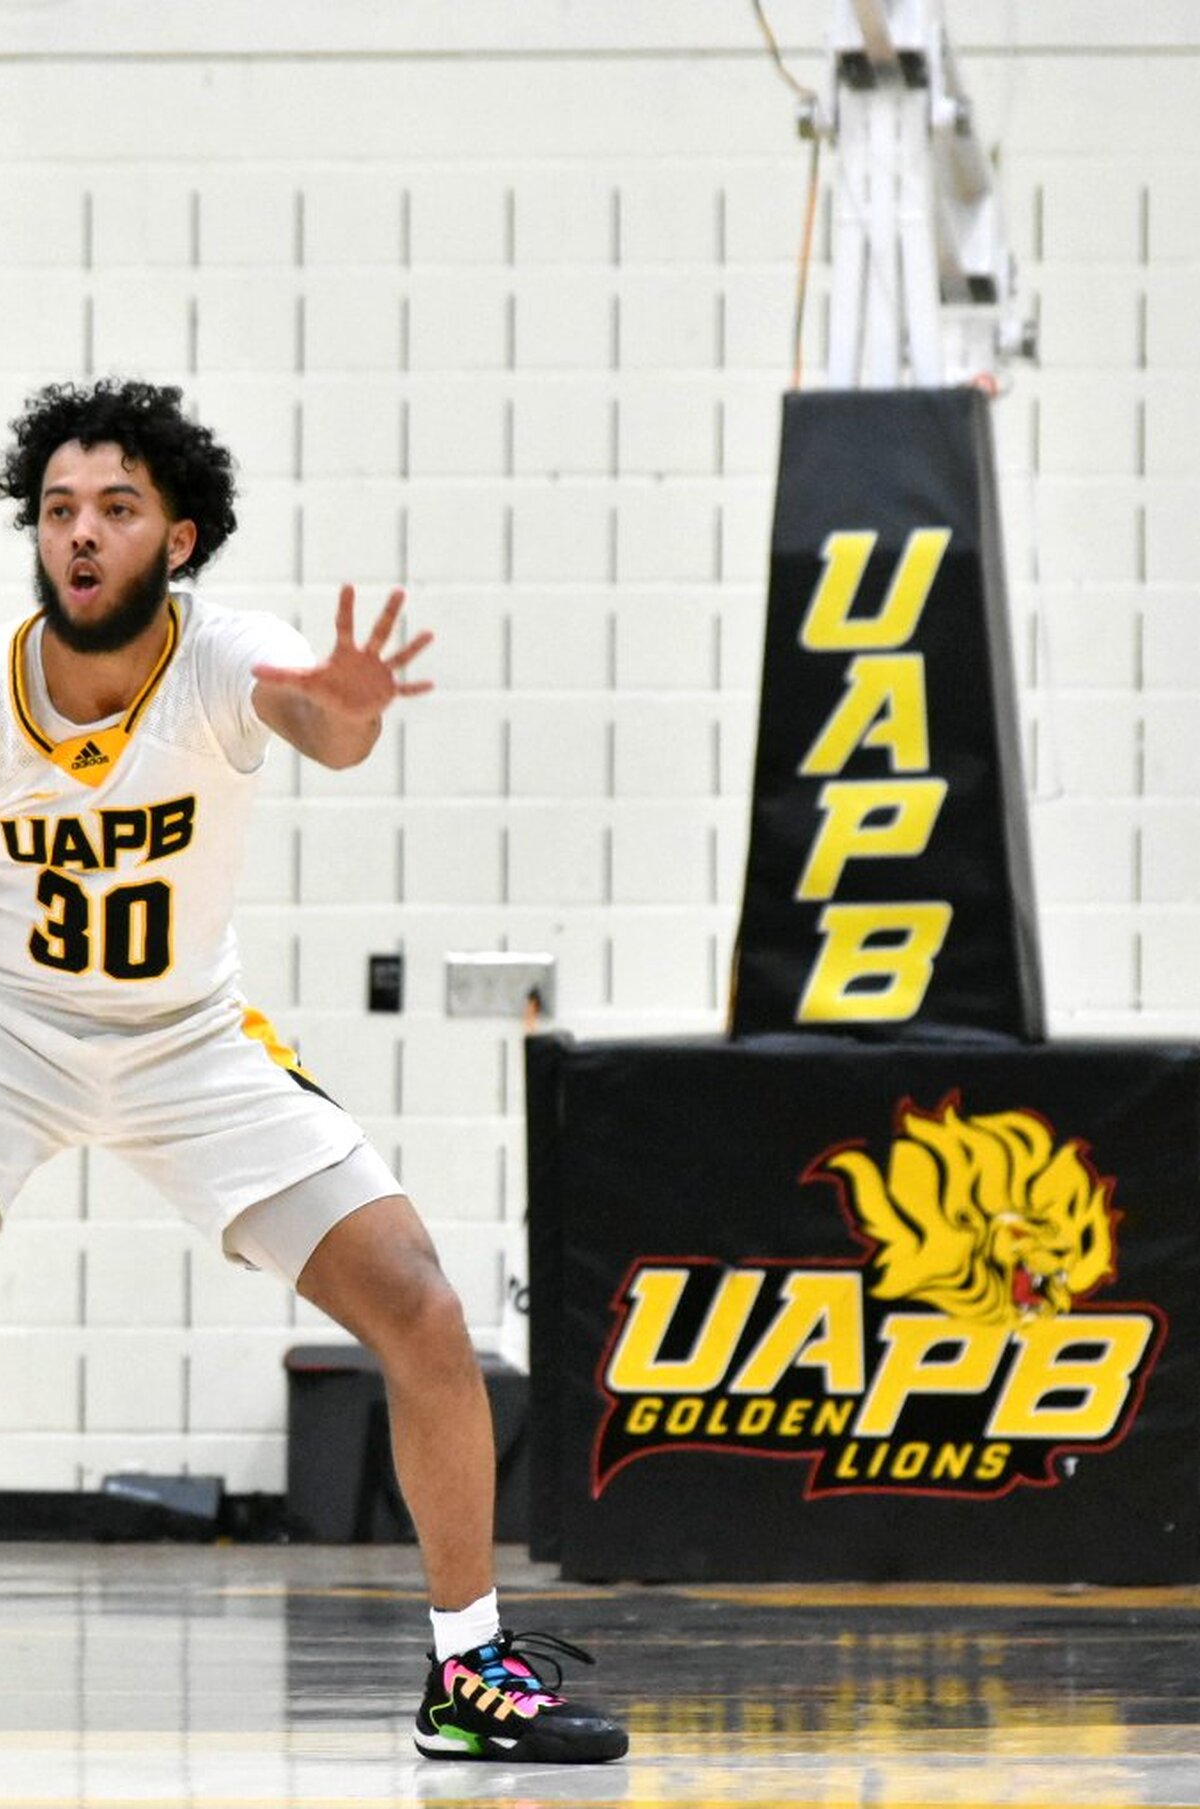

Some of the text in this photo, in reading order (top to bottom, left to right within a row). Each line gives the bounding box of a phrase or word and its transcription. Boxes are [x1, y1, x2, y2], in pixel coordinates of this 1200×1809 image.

[796, 527, 953, 1023] UAPB
[28, 867, 174, 983] 30
[606, 1268, 1154, 1440] UAPB
[626, 1398, 855, 1435] GOLDEN
[834, 1442, 1012, 1481] LIONS
